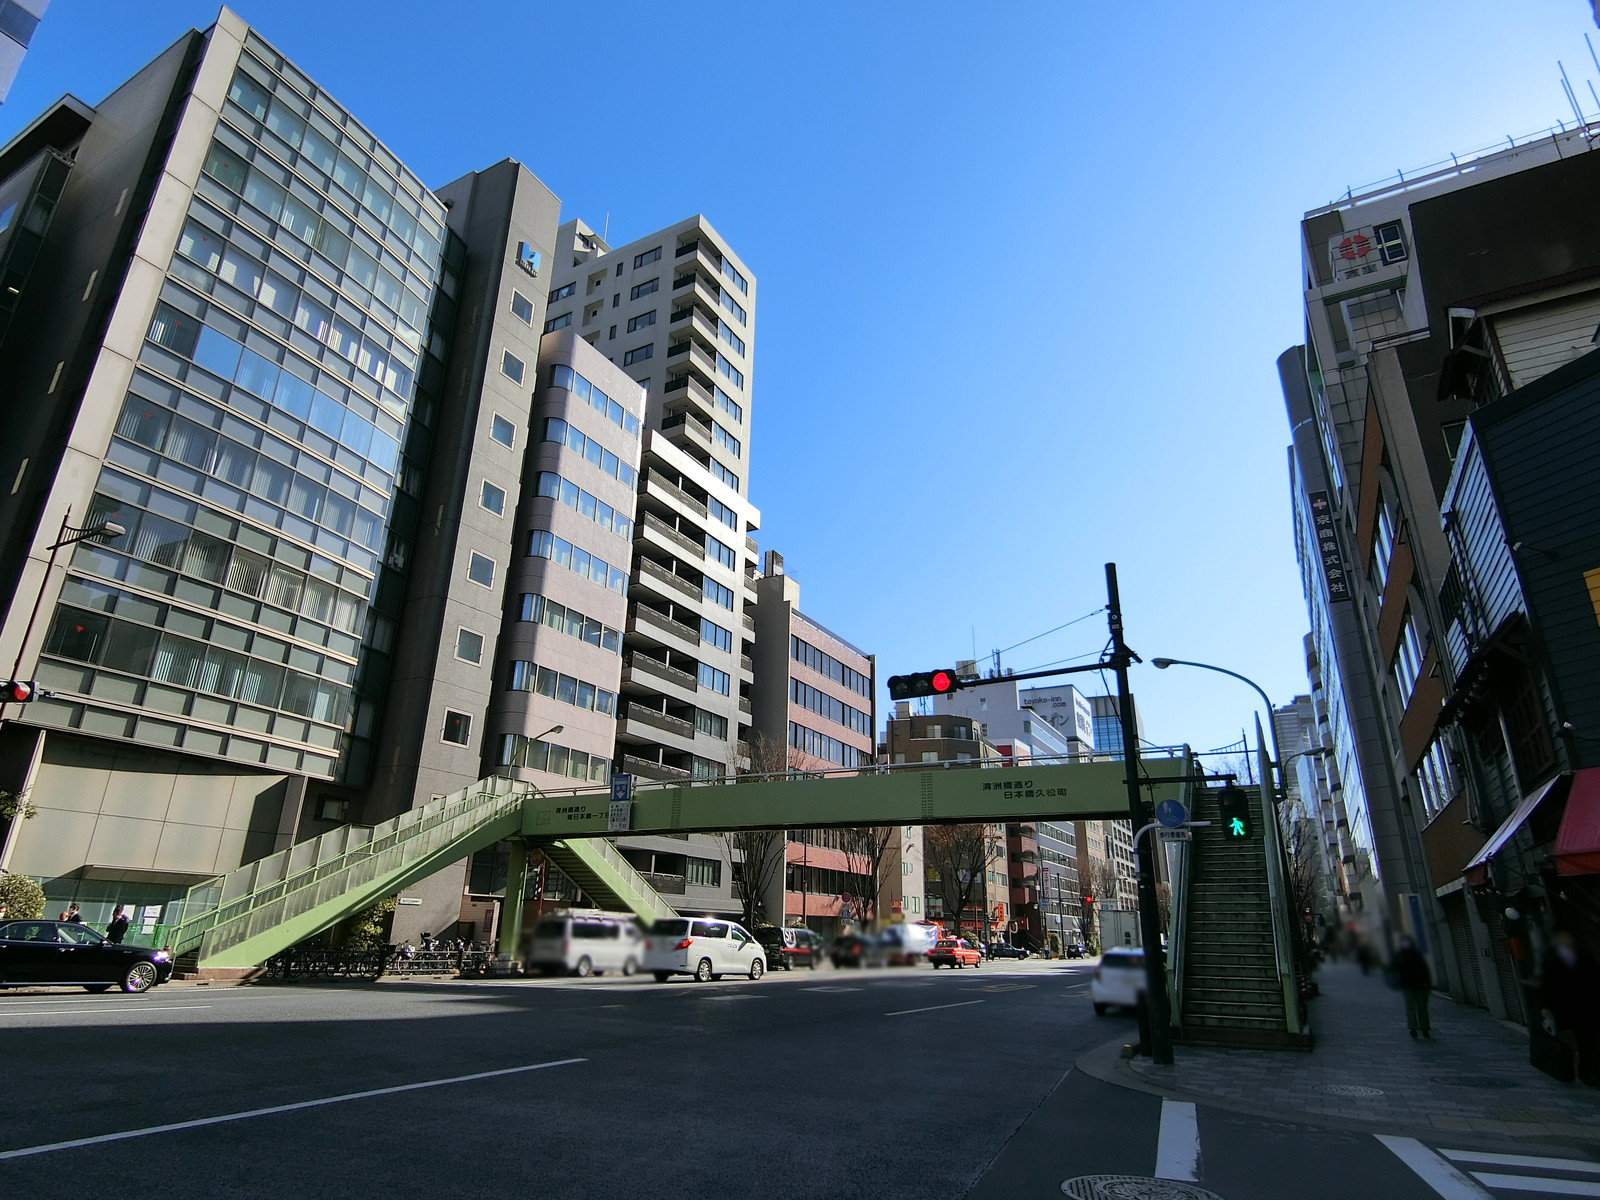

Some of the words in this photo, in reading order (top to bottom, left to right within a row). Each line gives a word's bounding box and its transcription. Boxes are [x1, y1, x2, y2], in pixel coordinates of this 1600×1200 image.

[1024, 696, 1062, 705] toyoko-inn
[982, 780, 1033, 791] 清洲橋通り
[1004, 788, 1067, 799] 日本橋久松町
